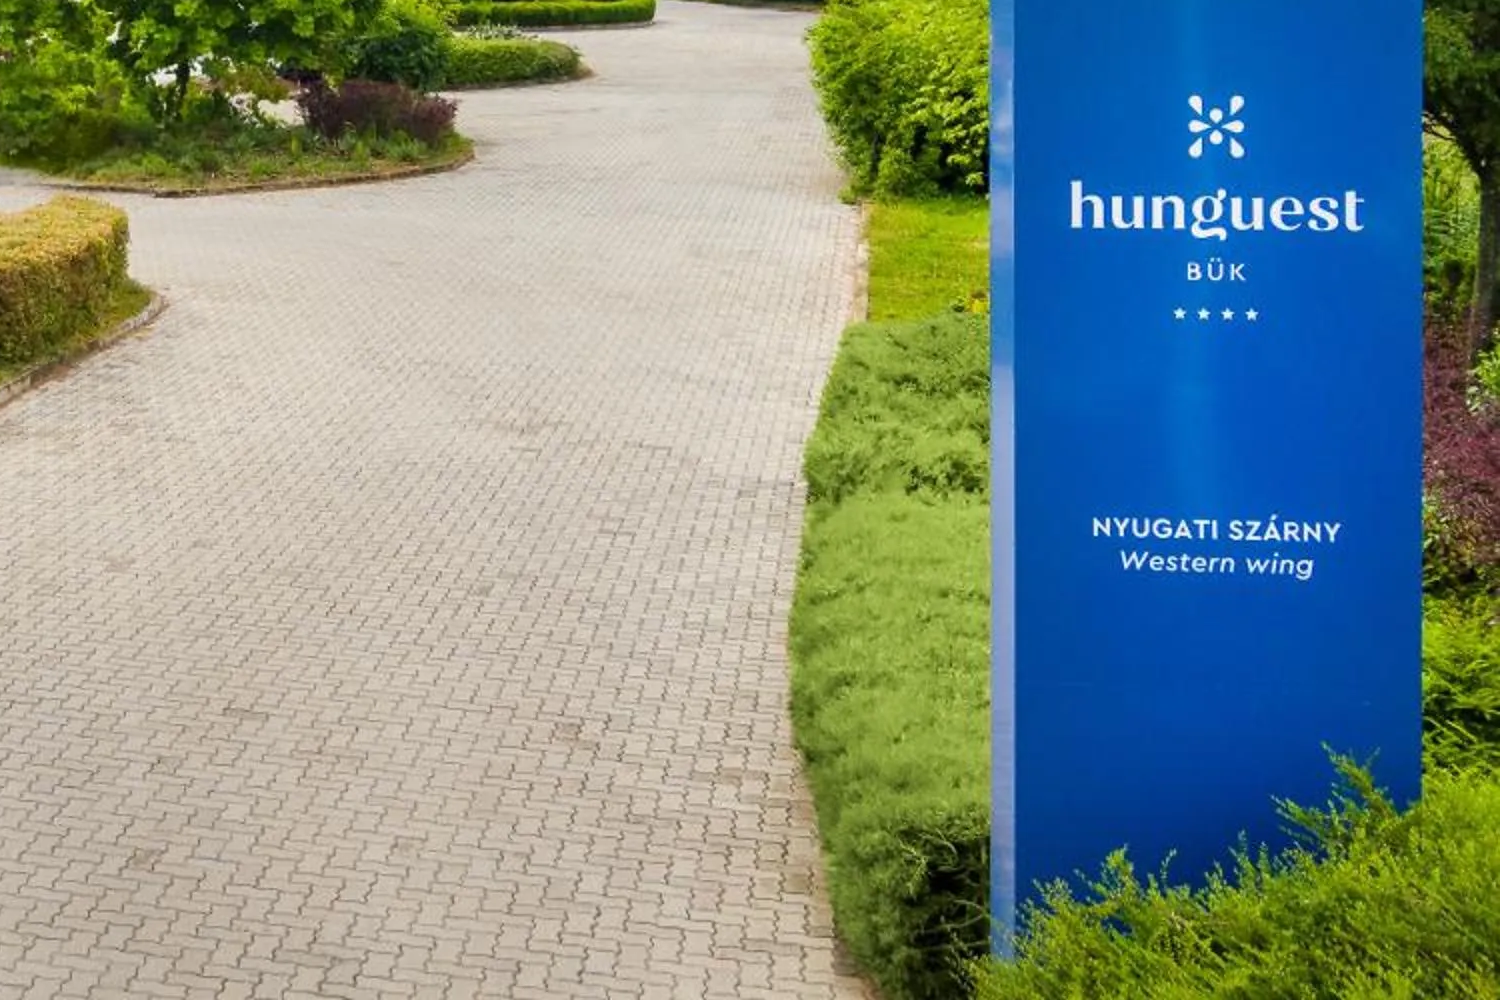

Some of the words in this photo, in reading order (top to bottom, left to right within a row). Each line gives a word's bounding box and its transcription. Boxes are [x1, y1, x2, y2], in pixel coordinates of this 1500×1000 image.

[1070, 180, 1365, 241] hunguest
[1186, 257, 1246, 281] BÜK
[1092, 516, 1219, 541] NYUGATI
[1228, 514, 1341, 543] SZÁRNY
[1120, 550, 1236, 574] Western
[1246, 553, 1314, 581] wing
